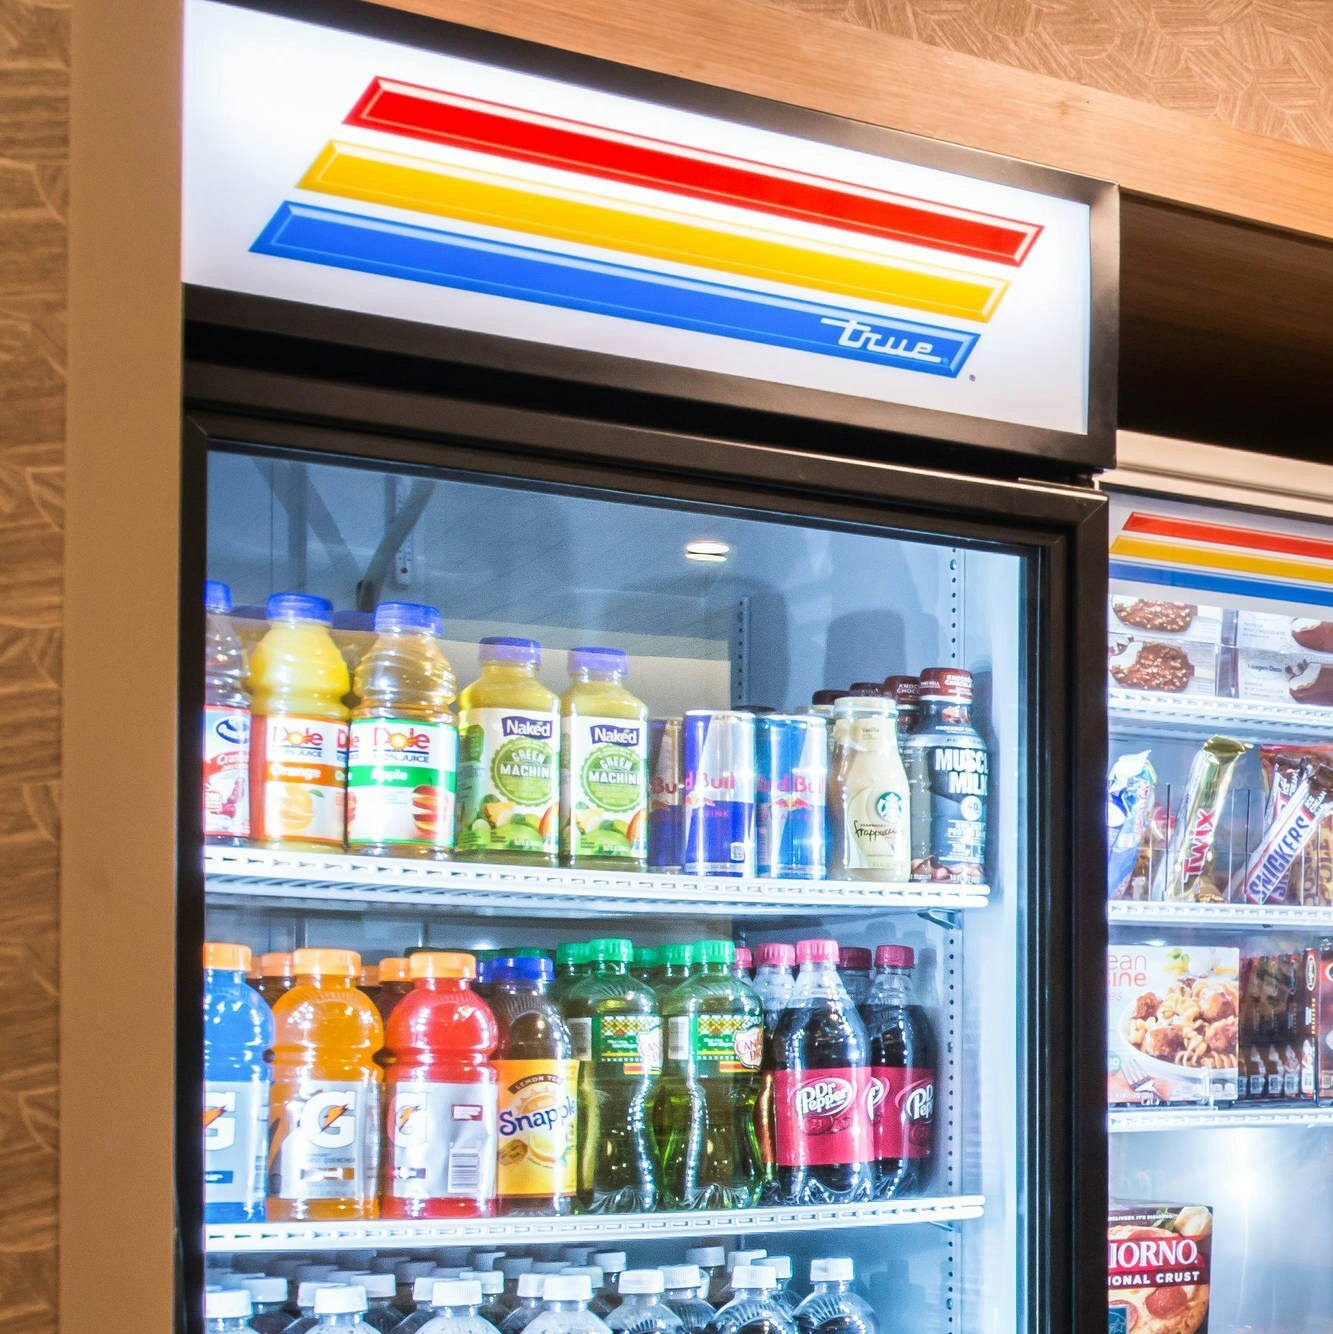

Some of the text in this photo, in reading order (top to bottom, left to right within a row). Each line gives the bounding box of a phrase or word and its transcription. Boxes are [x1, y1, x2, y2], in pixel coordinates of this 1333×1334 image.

[821, 317, 942, 363] true
[506, 719, 551, 737] Naked
[593, 728, 638, 745] Naked
[1183, 808, 1217, 883] TWIX
[1247, 815, 1309, 903] SNICKERS
[800, 1087, 849, 1113] Pepper
[815, 1082, 836, 1097] Dr
